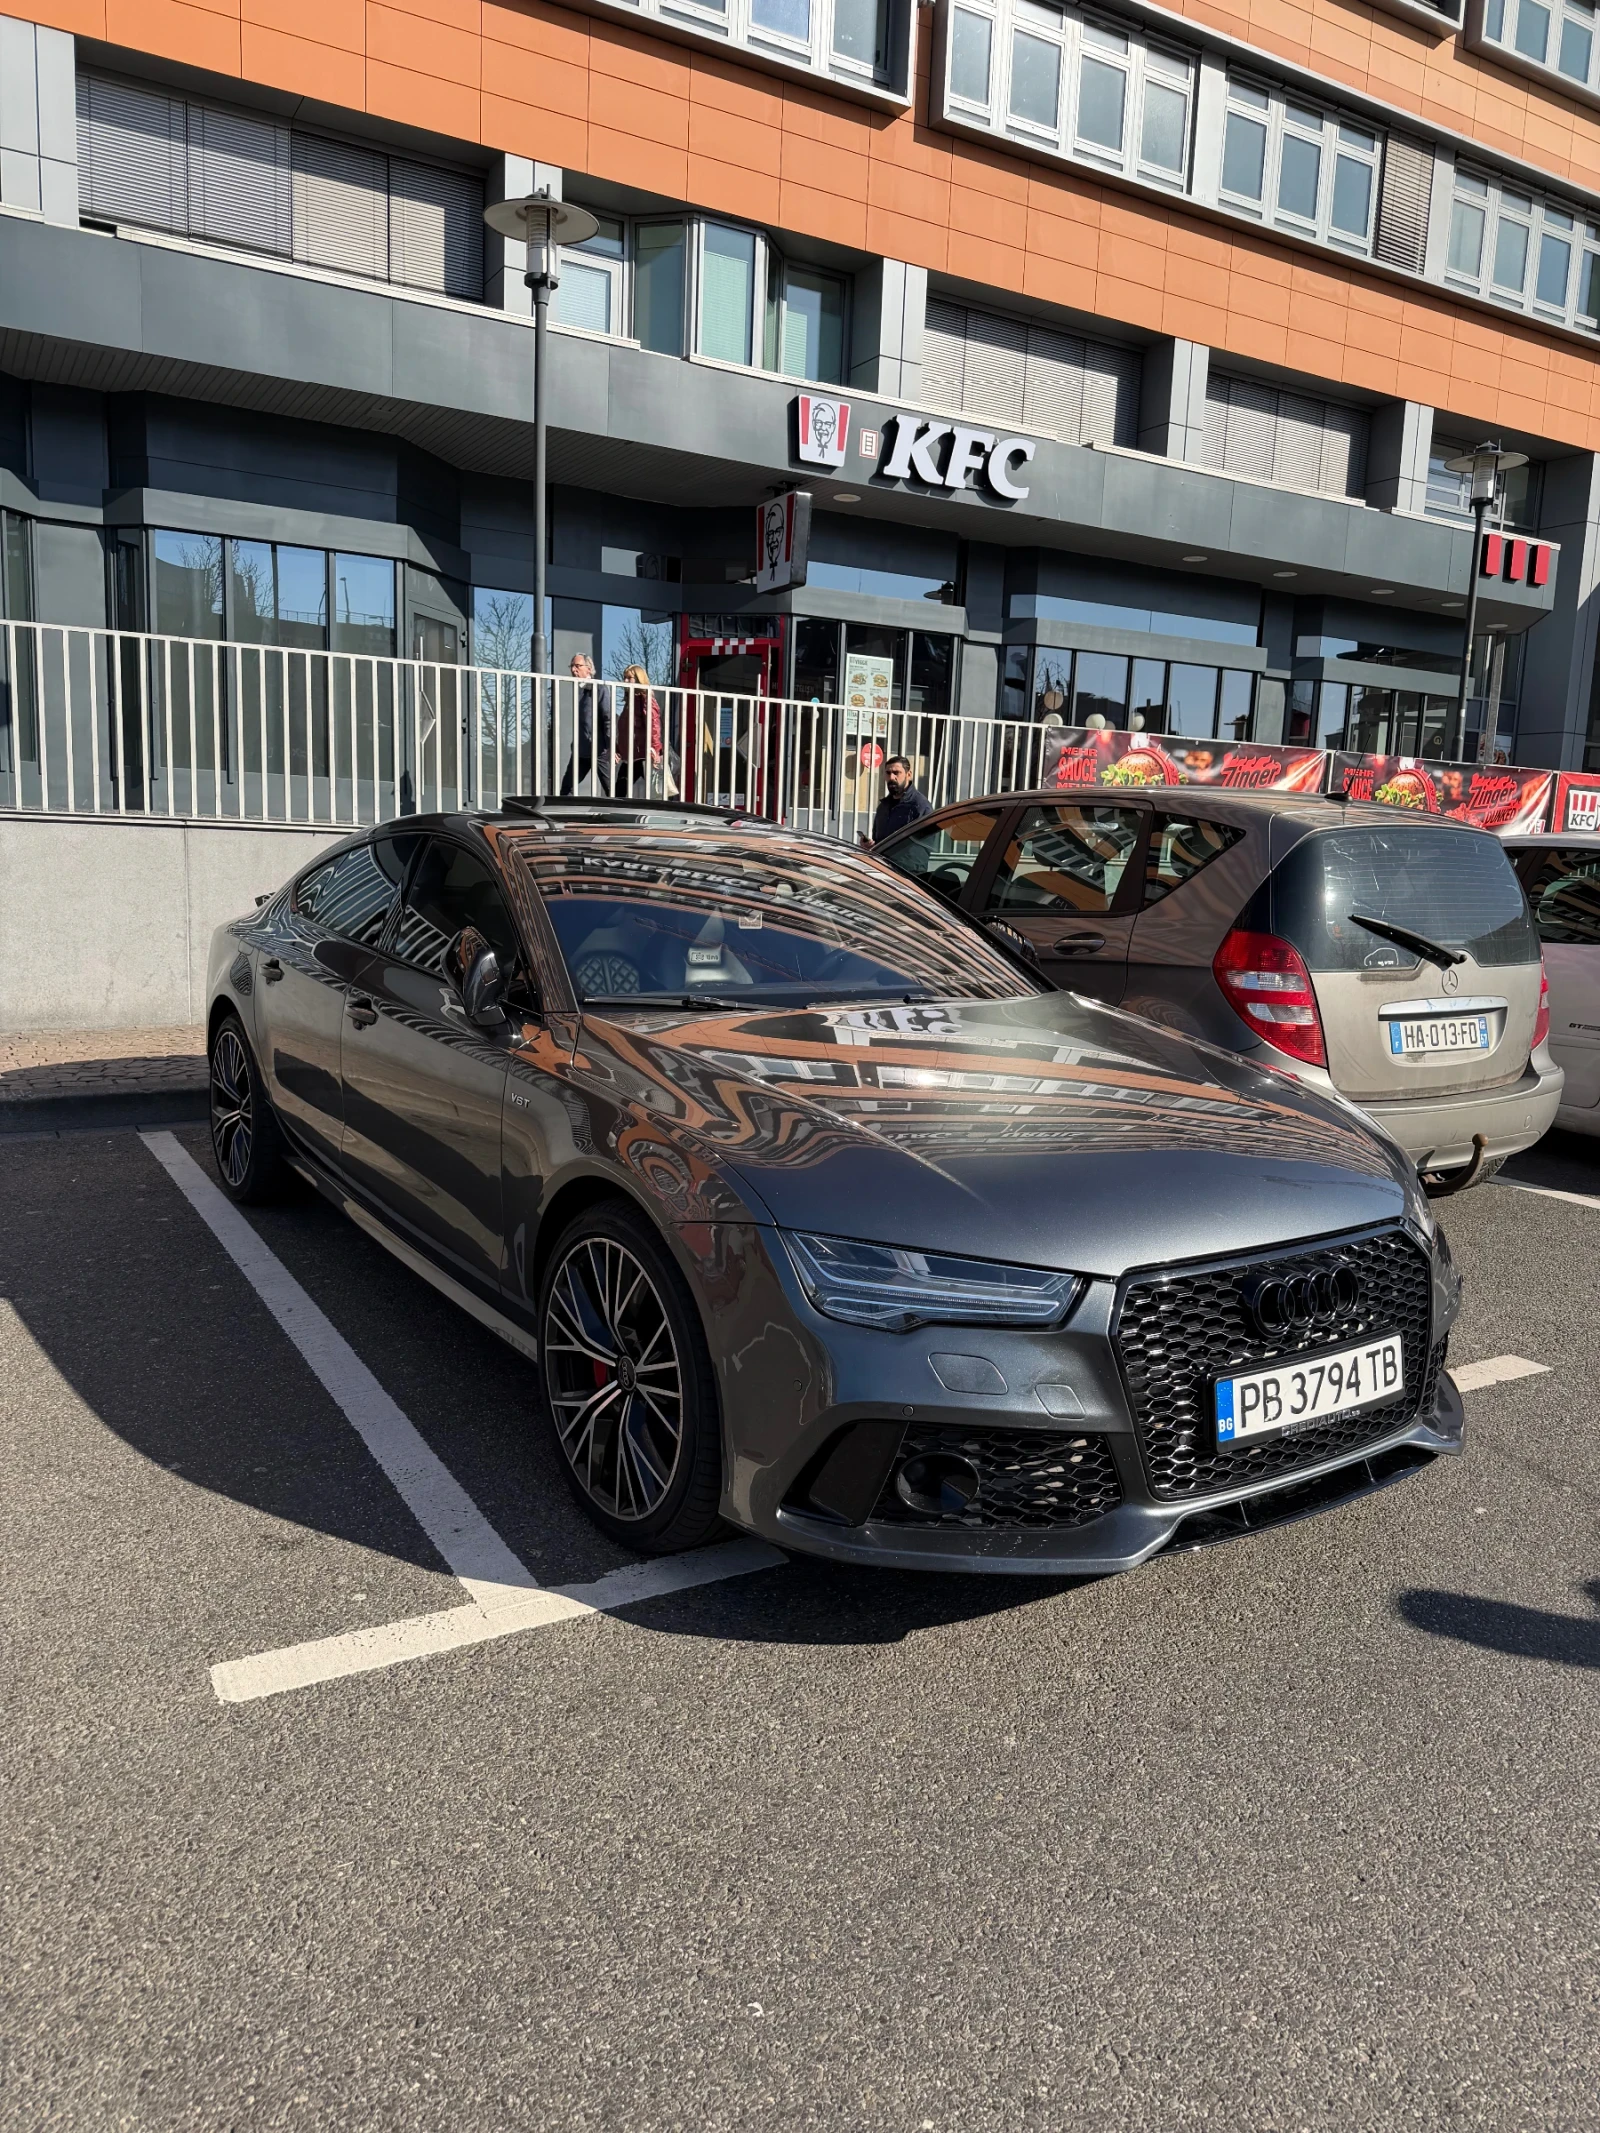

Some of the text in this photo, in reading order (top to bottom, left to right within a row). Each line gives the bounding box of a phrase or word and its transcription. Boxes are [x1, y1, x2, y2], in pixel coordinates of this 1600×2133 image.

[883, 414, 1036, 499] KFC
[1061, 746, 1098, 757] MEHR
[1057, 757, 1098, 782] SAUCE
[1343, 767, 1375, 778] MEHR
[1469, 785, 1517, 810] Zinger
[1484, 807, 1517, 825] DUNKED
[1570, 813, 1595, 827] KFC
[511, 1092, 531, 1108] V6T
[1218, 1344, 1398, 1433] BG PB 3794 TB
